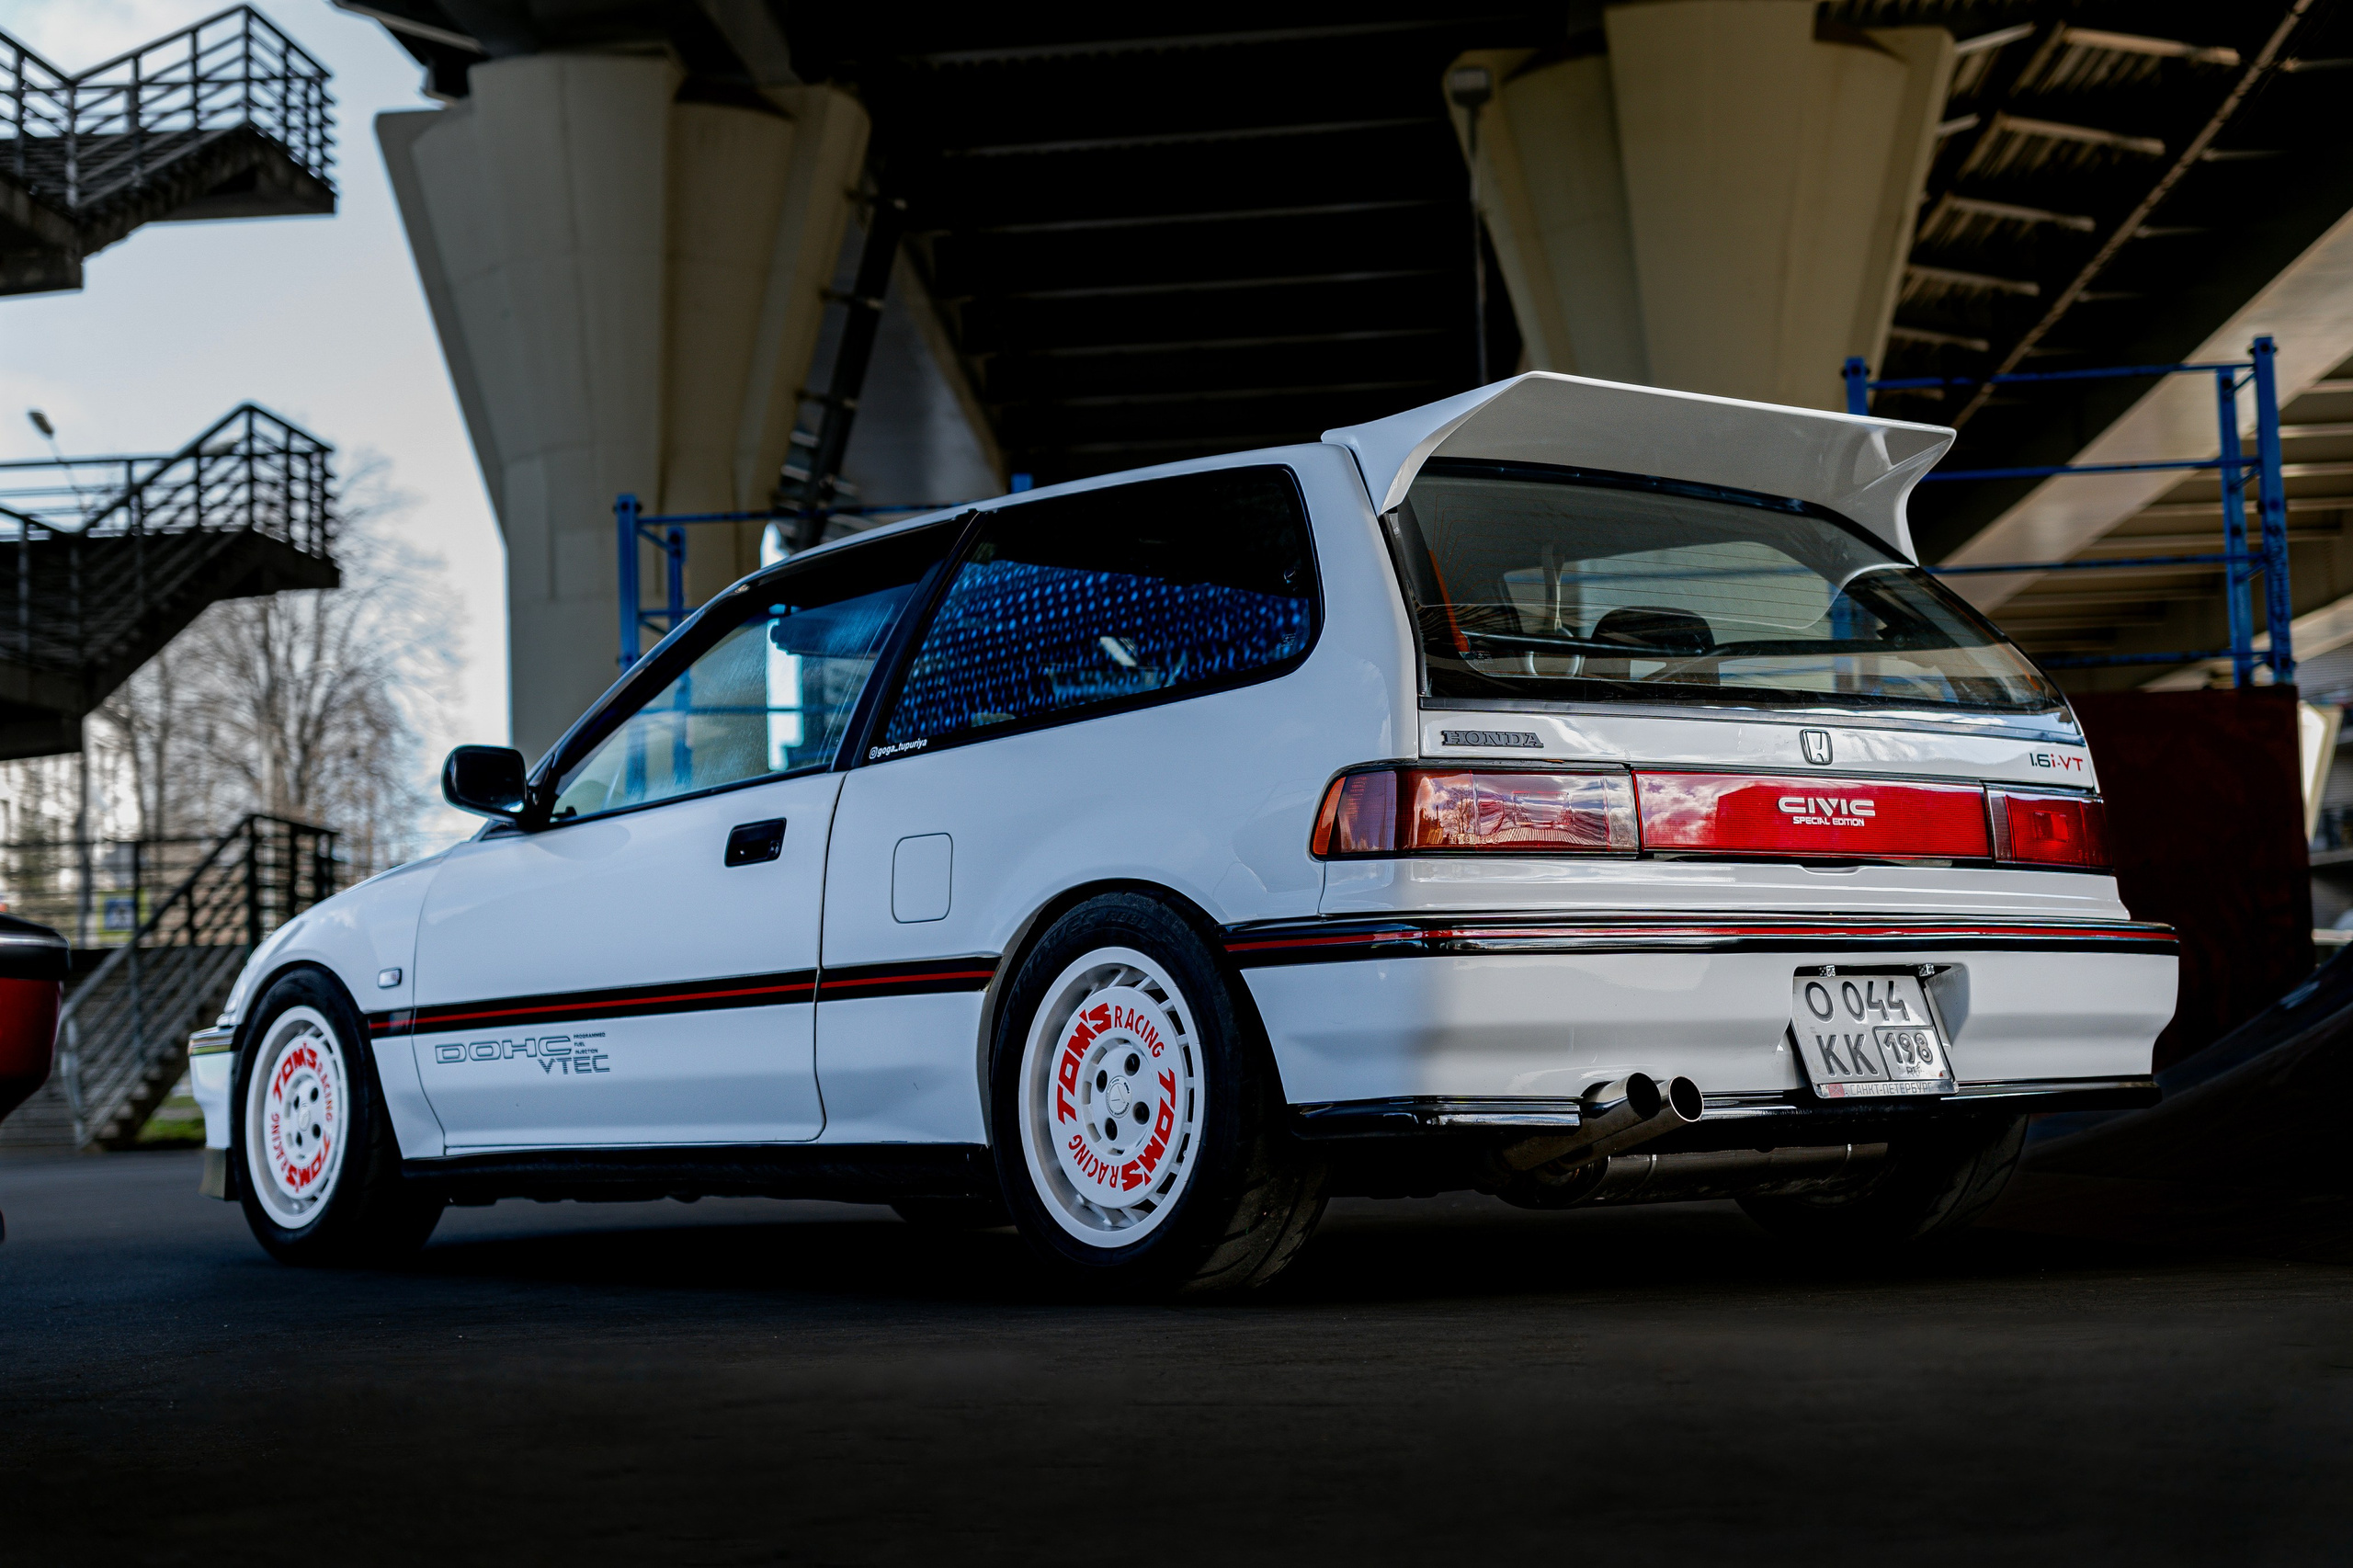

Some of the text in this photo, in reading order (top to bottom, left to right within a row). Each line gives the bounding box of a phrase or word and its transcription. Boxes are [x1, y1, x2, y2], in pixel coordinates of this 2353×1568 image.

[1441, 731, 1544, 748] HONDA
[1778, 797, 1876, 817] CIVIC
[1792, 816, 1865, 826] SPECIAL EDITION
[1841, 980, 1911, 1022] 044
[435, 1035, 572, 1064] DOHC
[538, 1055, 610, 1075] VTEC
[1058, 1003, 1112, 1125] TOM'S
[1114, 1005, 1165, 1059] RACING
[1883, 1032, 1934, 1065] 198
[273, 1042, 333, 1122] TOM'S RACING
[1850, 1082, 1932, 1095] САНКТ-ПЕТЕРБУРГ
[1121, 1068, 1176, 1192] TOM'S
[286, 1131, 330, 1193] TOM'S
[1068, 1134, 1119, 1189] RACING
